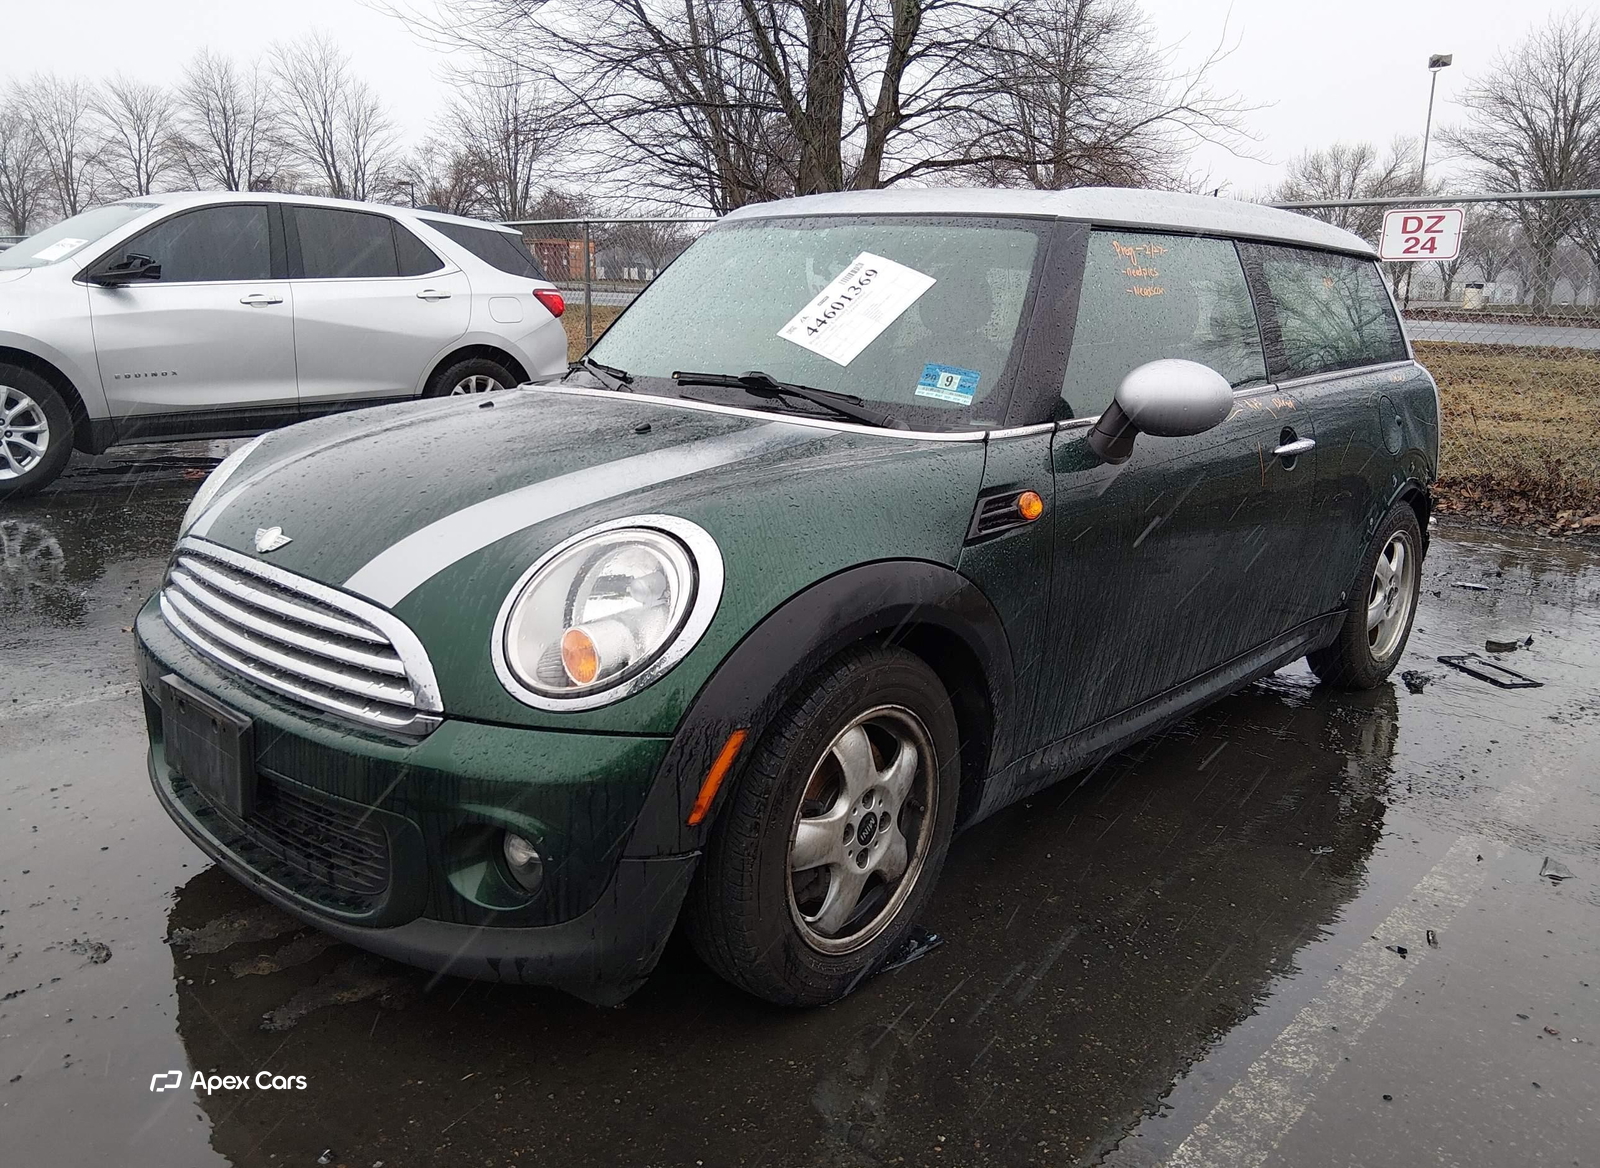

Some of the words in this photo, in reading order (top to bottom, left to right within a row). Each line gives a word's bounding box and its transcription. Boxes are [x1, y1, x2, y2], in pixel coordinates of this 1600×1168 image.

[1401, 215, 1446, 234] DZ
[1402, 236, 1437, 254] 24
[806, 268, 879, 338] 44601369
[114, 370, 178, 380] EQUINOX
[944, 375, 954, 387] 9
[861, 817, 875, 841] MINI
